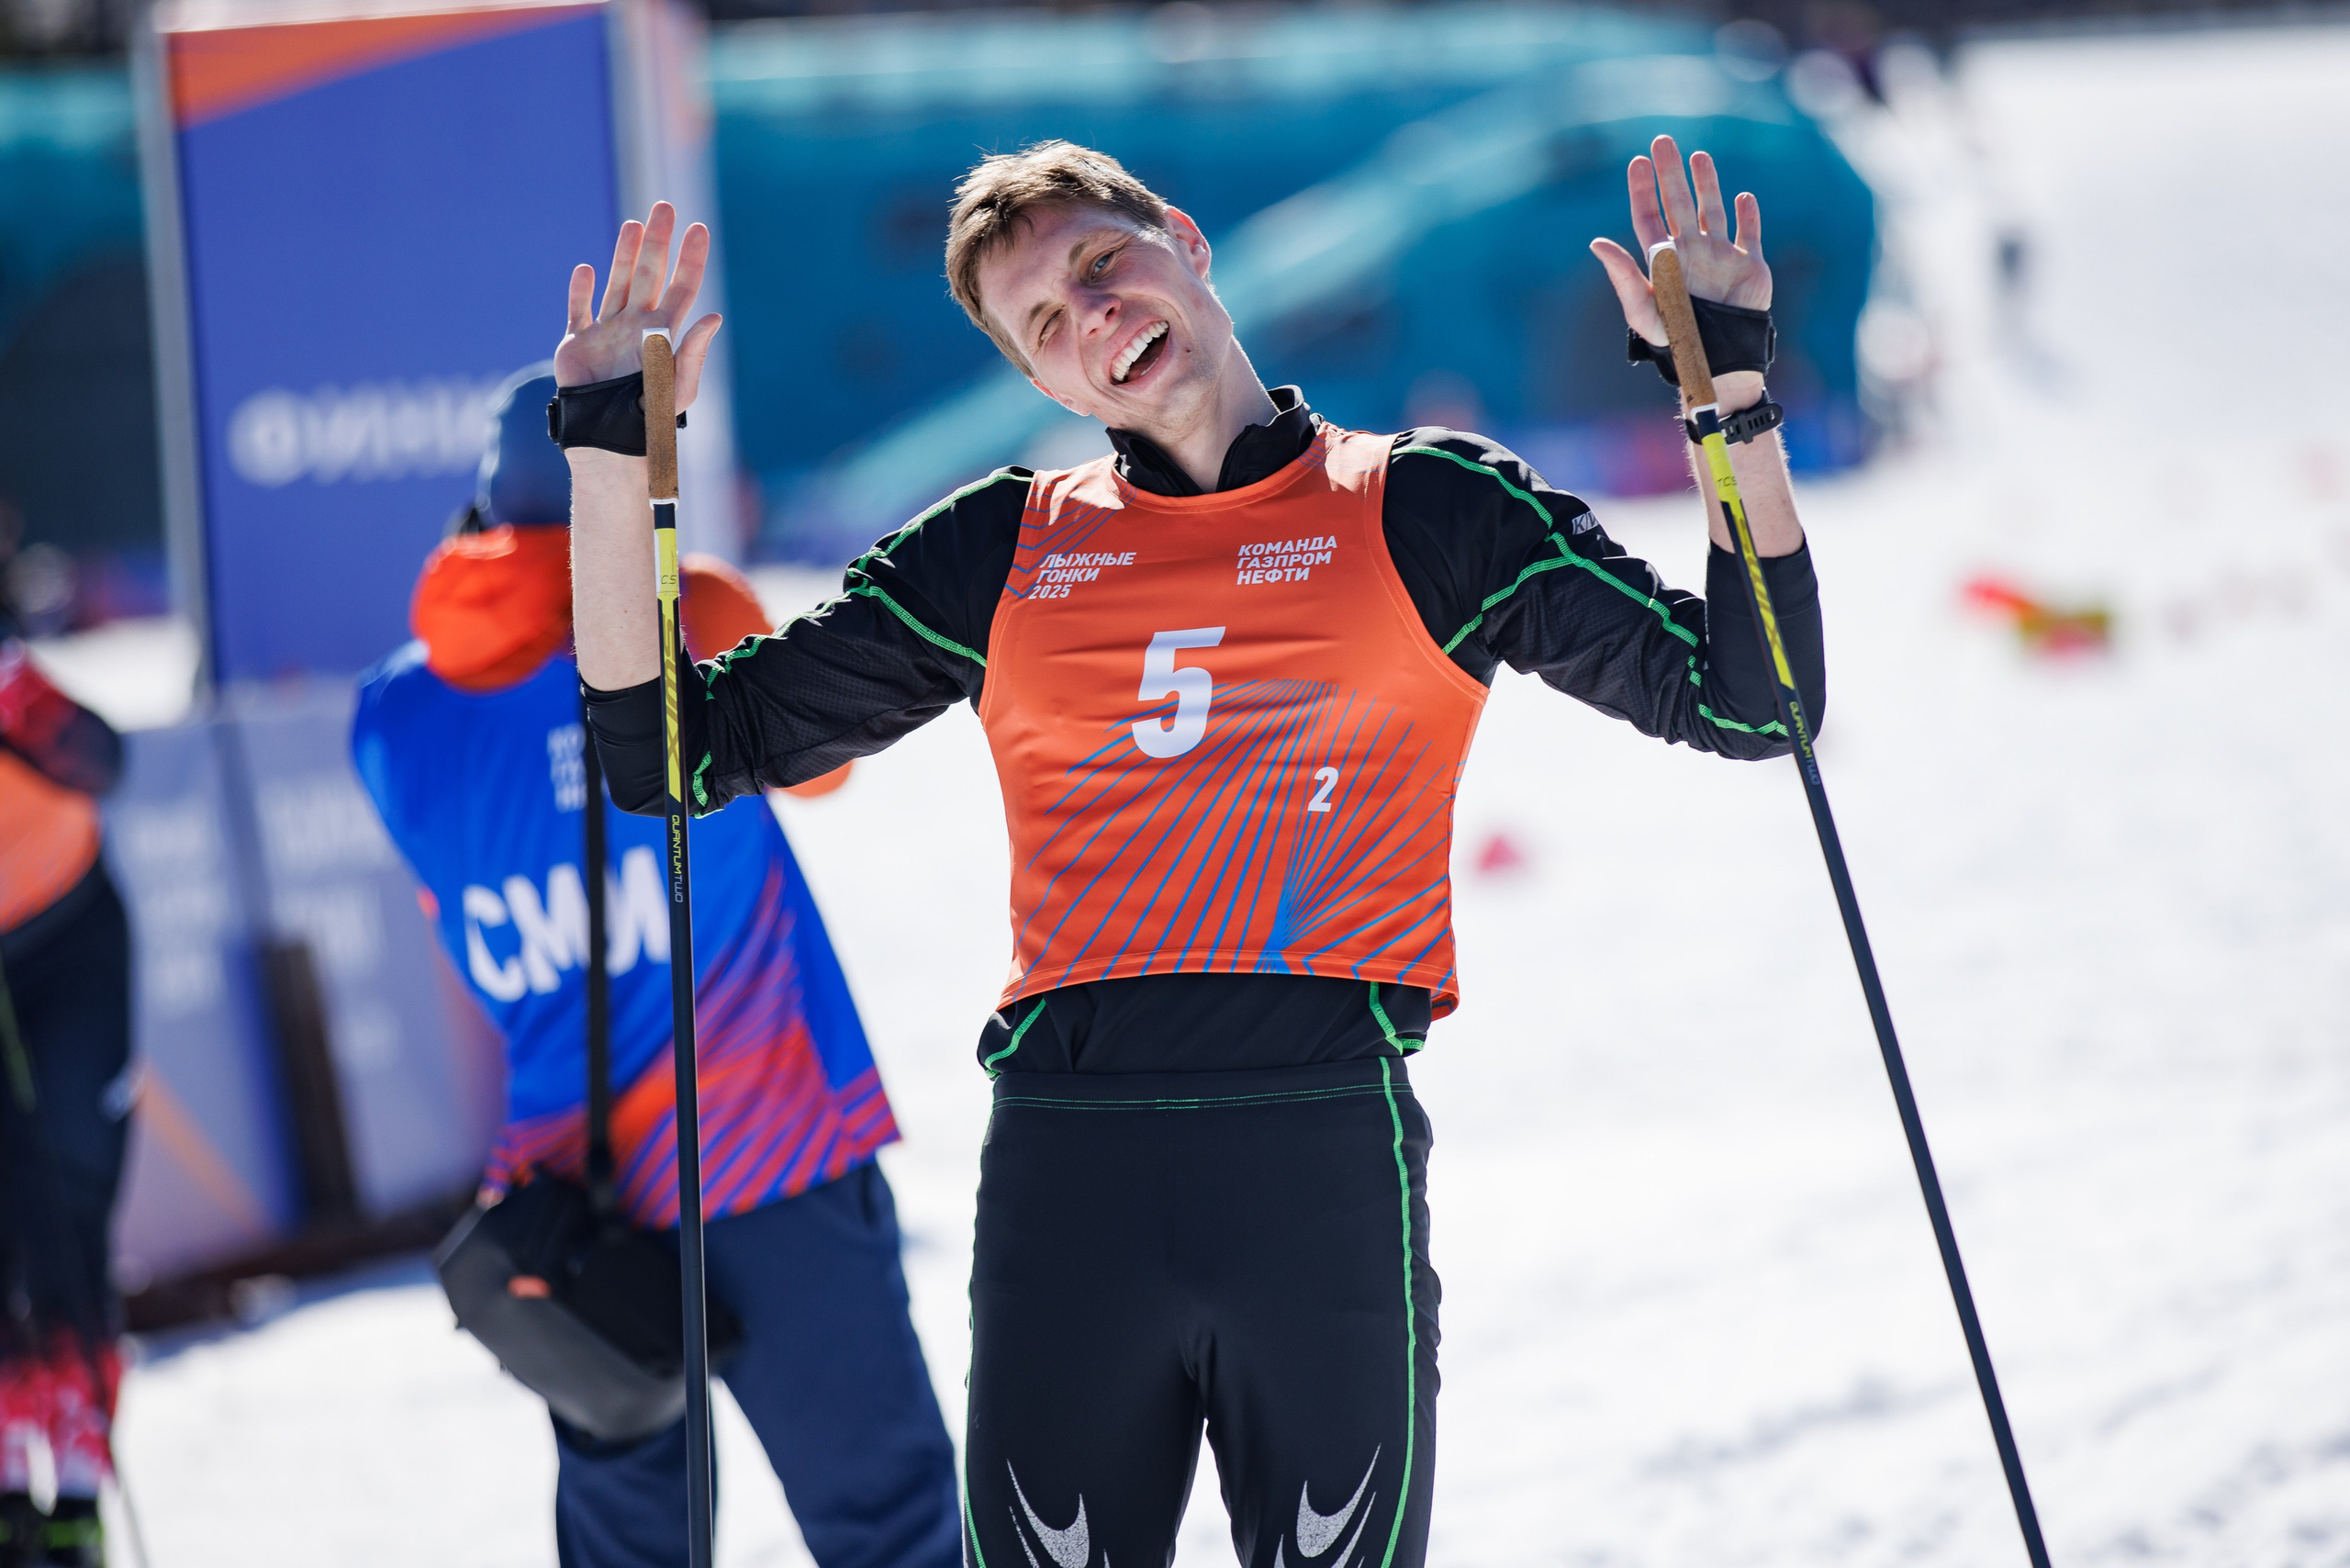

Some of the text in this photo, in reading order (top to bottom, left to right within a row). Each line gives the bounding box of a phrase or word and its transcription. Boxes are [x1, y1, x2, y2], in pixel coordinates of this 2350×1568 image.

[1237, 535, 1337, 556] КОМАНДА
[1039, 552, 1136, 568] ЛЫЖНЫЕ
[1237, 551, 1332, 569] ГАЗПРОМ
[1035, 567, 1101, 584] ГОНКИ
[1237, 567, 1310, 585] НЕФТИ
[1028, 584, 1072, 599] 2025
[1131, 626, 1226, 758] 5
[1306, 766, 1339, 812] 2
[462, 843, 672, 1002] СМИ
